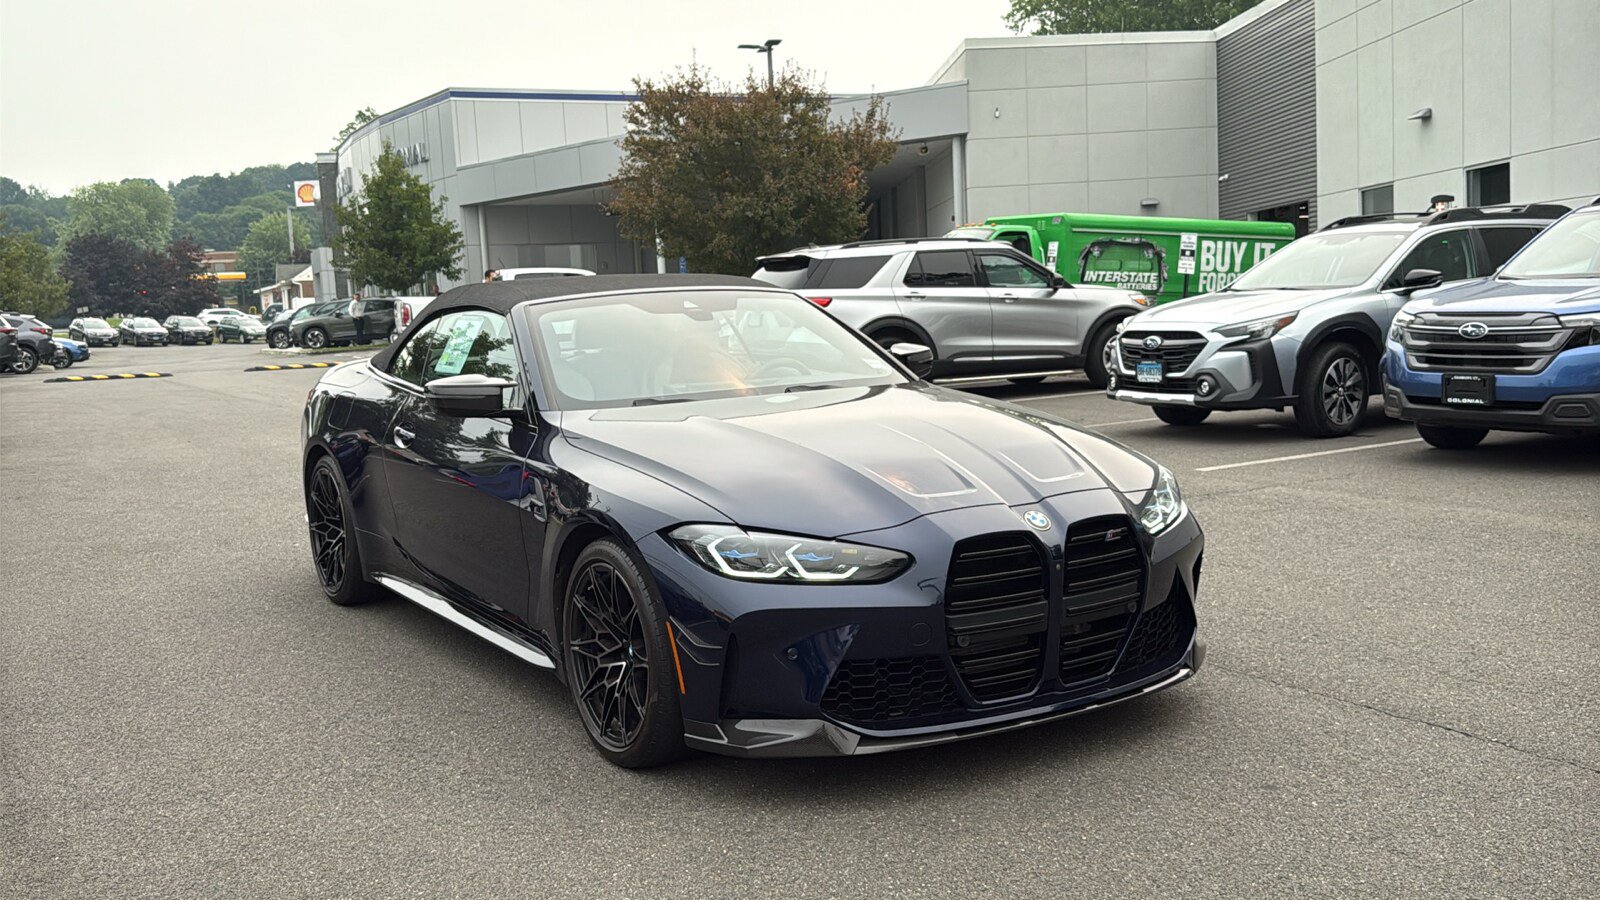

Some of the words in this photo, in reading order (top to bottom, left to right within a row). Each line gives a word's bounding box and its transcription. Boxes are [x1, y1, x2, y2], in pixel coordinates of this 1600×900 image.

[1200, 240, 1248, 273] BUY
[1253, 242, 1276, 266] IT
[1083, 270, 1159, 284] INTERSTATE
[1198, 271, 1243, 294] FOR
[1117, 282, 1158, 291] BATTERIES
[1447, 397, 1484, 405] COLONIAL
